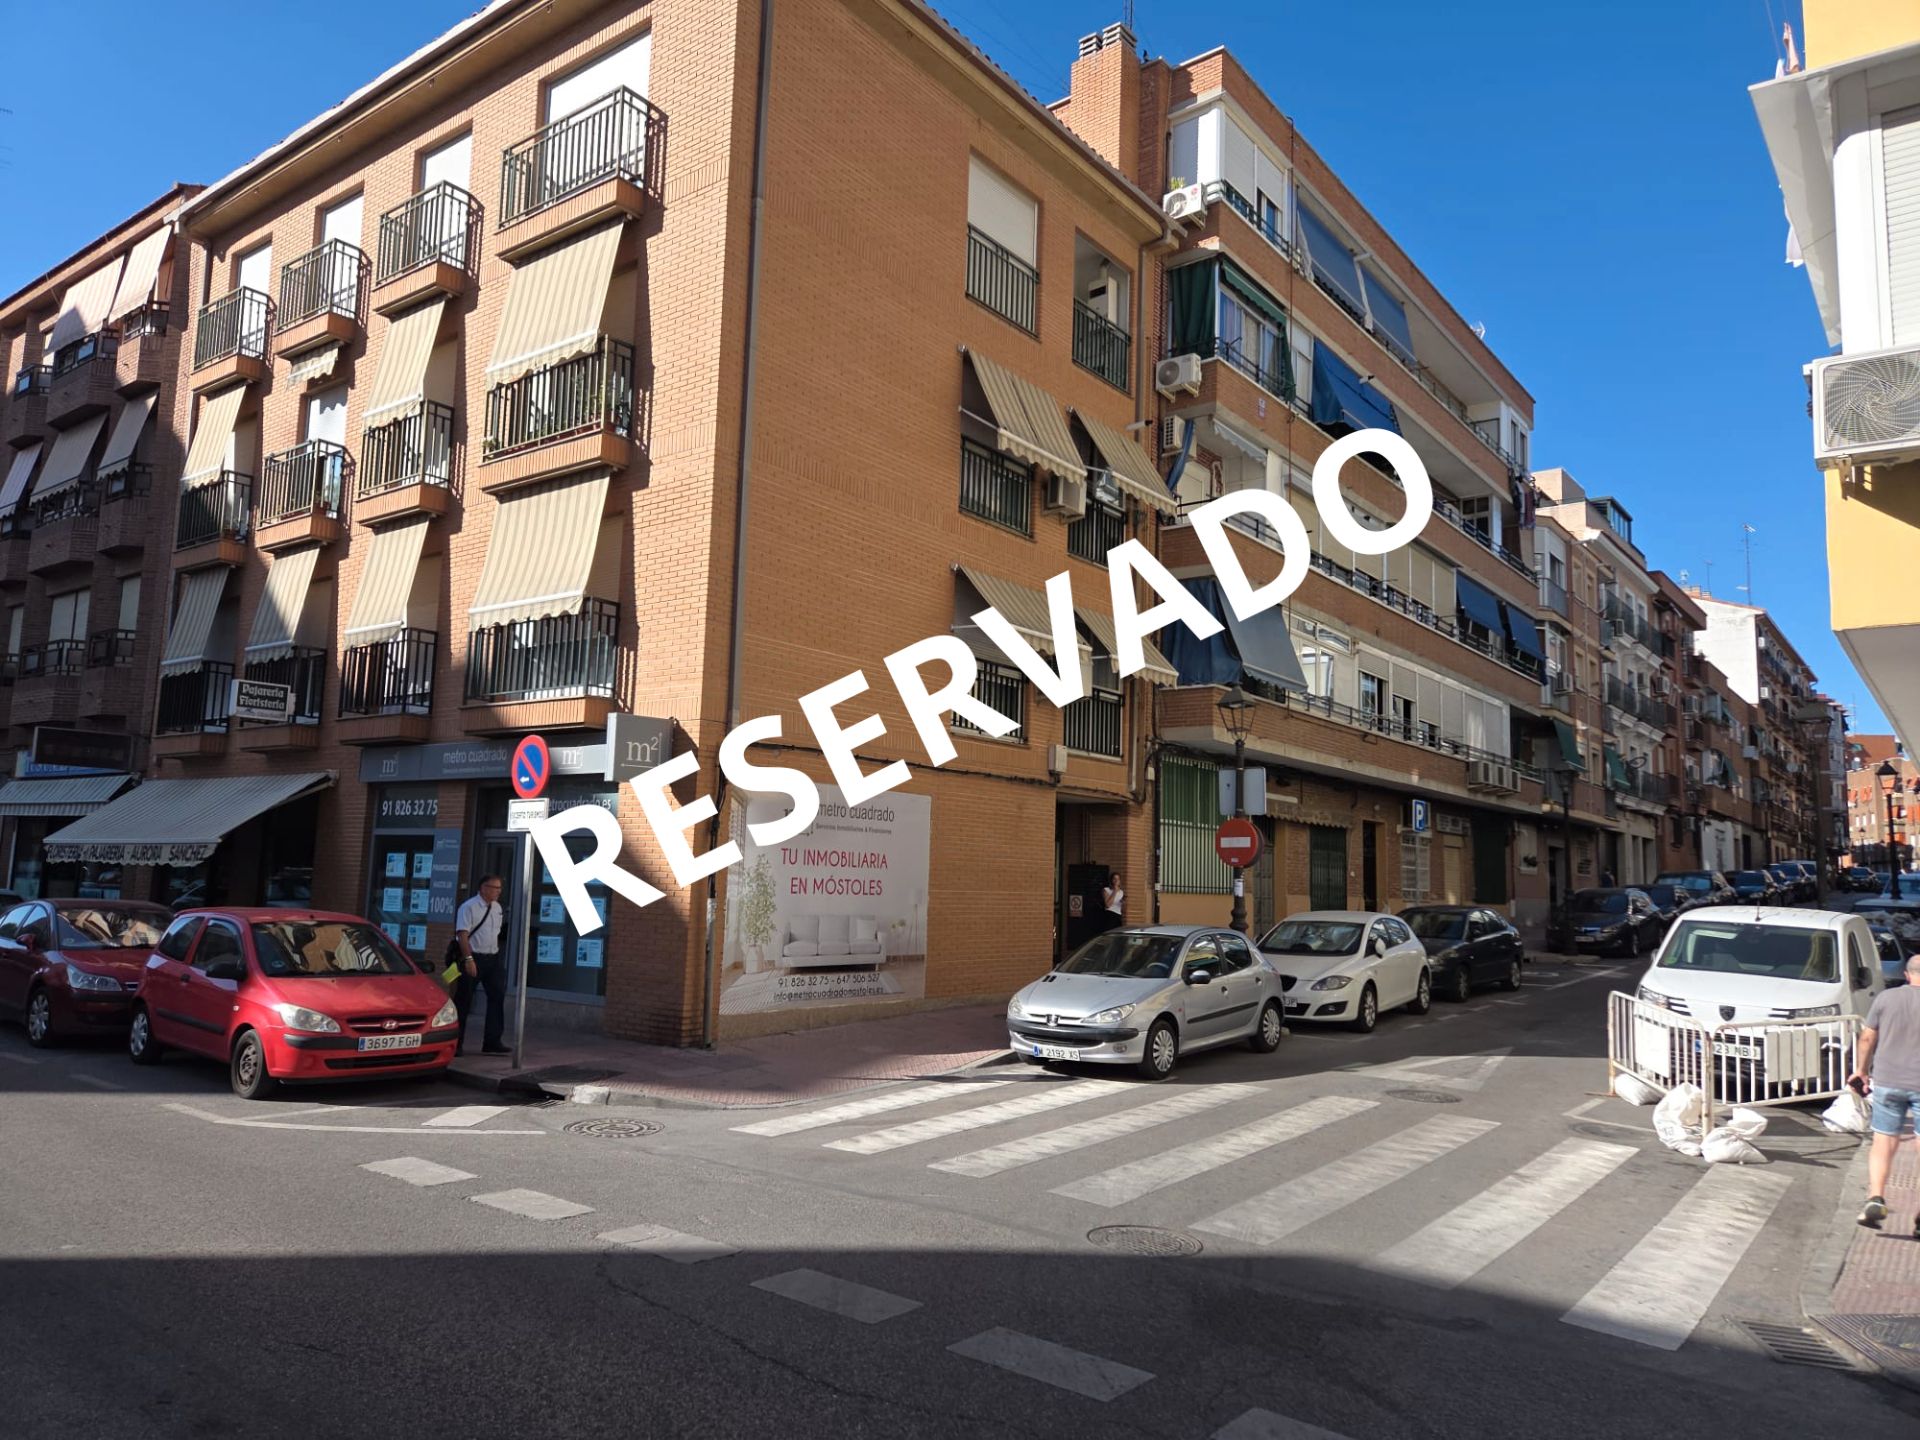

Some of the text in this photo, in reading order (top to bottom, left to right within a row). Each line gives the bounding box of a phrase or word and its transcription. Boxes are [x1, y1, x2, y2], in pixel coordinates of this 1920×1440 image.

[443, 747, 507, 764] metro cuadrado
[382, 799, 438, 816] 91 826 32 75
[819, 802, 895, 822] metro cuadrado
[1416, 803, 1424, 830] P
[781, 848, 888, 869] TU INMOBILIARIA
[790, 875, 883, 896] EN MÓSTOLES
[430, 896, 454, 914] 100%
[778, 978, 787, 988] 91
[791, 977, 805, 988] 826
[808, 976, 818, 986] 32
[820, 975, 829, 985] 75
[837, 975, 850, 985] 647
[367, 1035, 420, 1050] 3697 FGH
[1046, 1048, 1066, 1059] 2192
